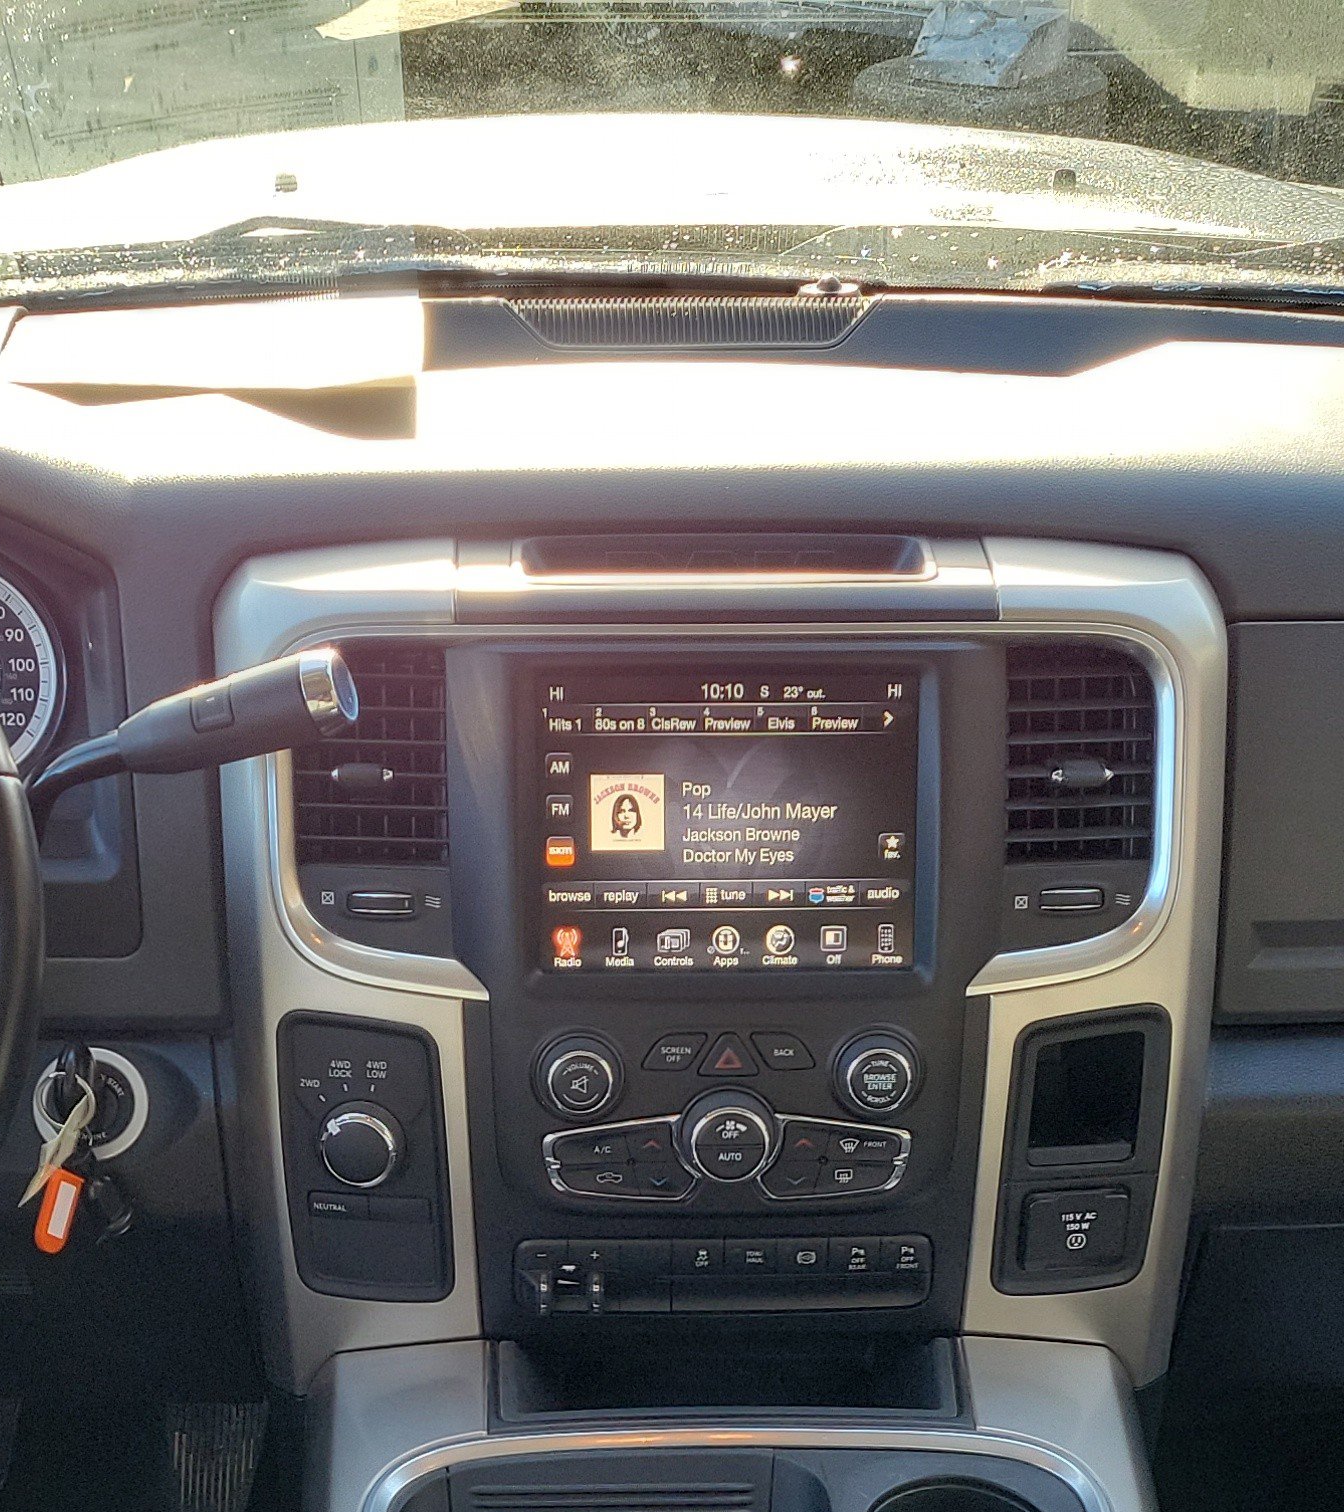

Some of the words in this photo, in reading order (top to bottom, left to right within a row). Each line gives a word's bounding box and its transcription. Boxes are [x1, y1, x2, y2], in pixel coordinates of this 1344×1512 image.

[5, 629, 24, 642] 90
[8, 658, 35, 672] 100
[10, 688, 34, 702] 110
[549, 686, 563, 701] HI
[701, 683, 744, 699] 10:10
[760, 685, 769, 698] S
[783, 686, 804, 698] 23°
[807, 689, 826, 699] out.
[887, 684, 902, 698] HI
[542, 707, 548, 718] 1
[595, 707, 602, 717] 2
[649, 707, 656, 716] 3
[703, 707, 710, 716] 4
[757, 707, 764, 716] 5
[0, 713, 26, 726] 120
[549, 718, 572, 730] Hits
[575, 718, 582, 731] 1
[595, 718, 616, 730] 80s
[619, 721, 634, 730] on
[637, 718, 645, 730] 8
[704, 717, 751, 731] Preview
[768, 717, 795, 730] Elvis
[812, 717, 858, 731] Preview
[550, 761, 570, 774] AM
[682, 782, 711, 798] Pop
[551, 803, 570, 816] FM
[683, 803, 702, 820] 14
[708, 803, 780, 820] Life/John
[786, 803, 838, 822] Mayer
[682, 828, 741, 842] Jackson
[746, 828, 800, 841] Browne
[683, 849, 732, 863] Doctor
[734, 849, 756, 864] My
[760, 848, 794, 864] Eyes
[548, 890, 591, 902] browse
[603, 890, 639, 904] replay
[721, 888, 746, 900] tune
[867, 887, 900, 899] audio
[554, 957, 582, 967] Radio
[605, 957, 634, 967] Media
[654, 956, 694, 966] Controls
[714, 957, 739, 968] Apps
[762, 955, 798, 965] Climate
[827, 955, 842, 965] Off
[871, 955, 903, 965] Phone
[330, 1060, 351, 1069] 4WD
[366, 1060, 387, 1070] 4WD
[566, 1062, 594, 1072] VOLUME
[328, 1069, 352, 1078] LOCK
[366, 1070, 387, 1078] LOW
[864, 1073, 897, 1081] BROWSE
[299, 1078, 320, 1088] 2WD
[867, 1082, 892, 1090] ENTER
[721, 1131, 739, 1139] OFF
[593, 1145, 611, 1154] A/C
[718, 1152, 742, 1161] AUTO
[313, 1202, 346, 1212] NEUTRAL
[1084, 1212, 1097, 1220] AC
[1081, 1222, 1090, 1230] W
